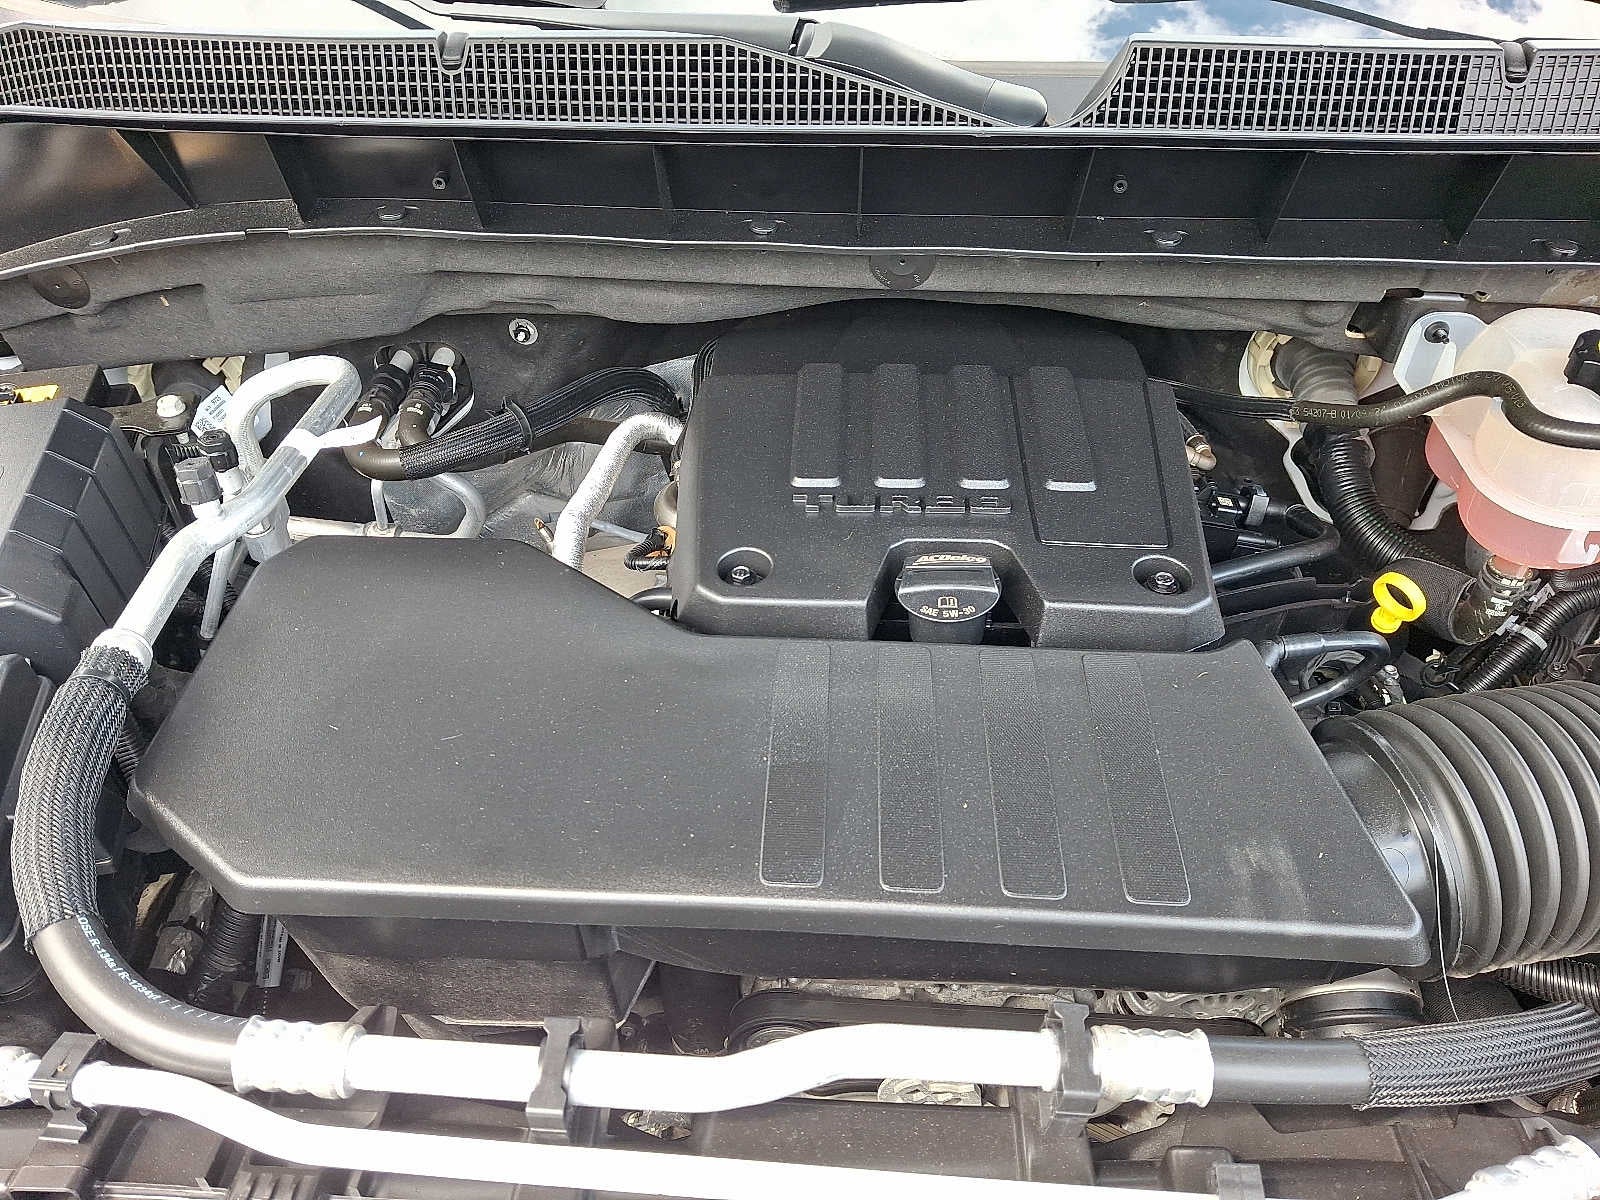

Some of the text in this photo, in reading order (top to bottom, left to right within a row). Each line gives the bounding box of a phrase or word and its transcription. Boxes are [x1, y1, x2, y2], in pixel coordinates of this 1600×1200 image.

[791, 493, 1012, 515] TURBO
[913, 554, 988, 565] ACDelco
[919, 605, 977, 619] SAE 5W-30
